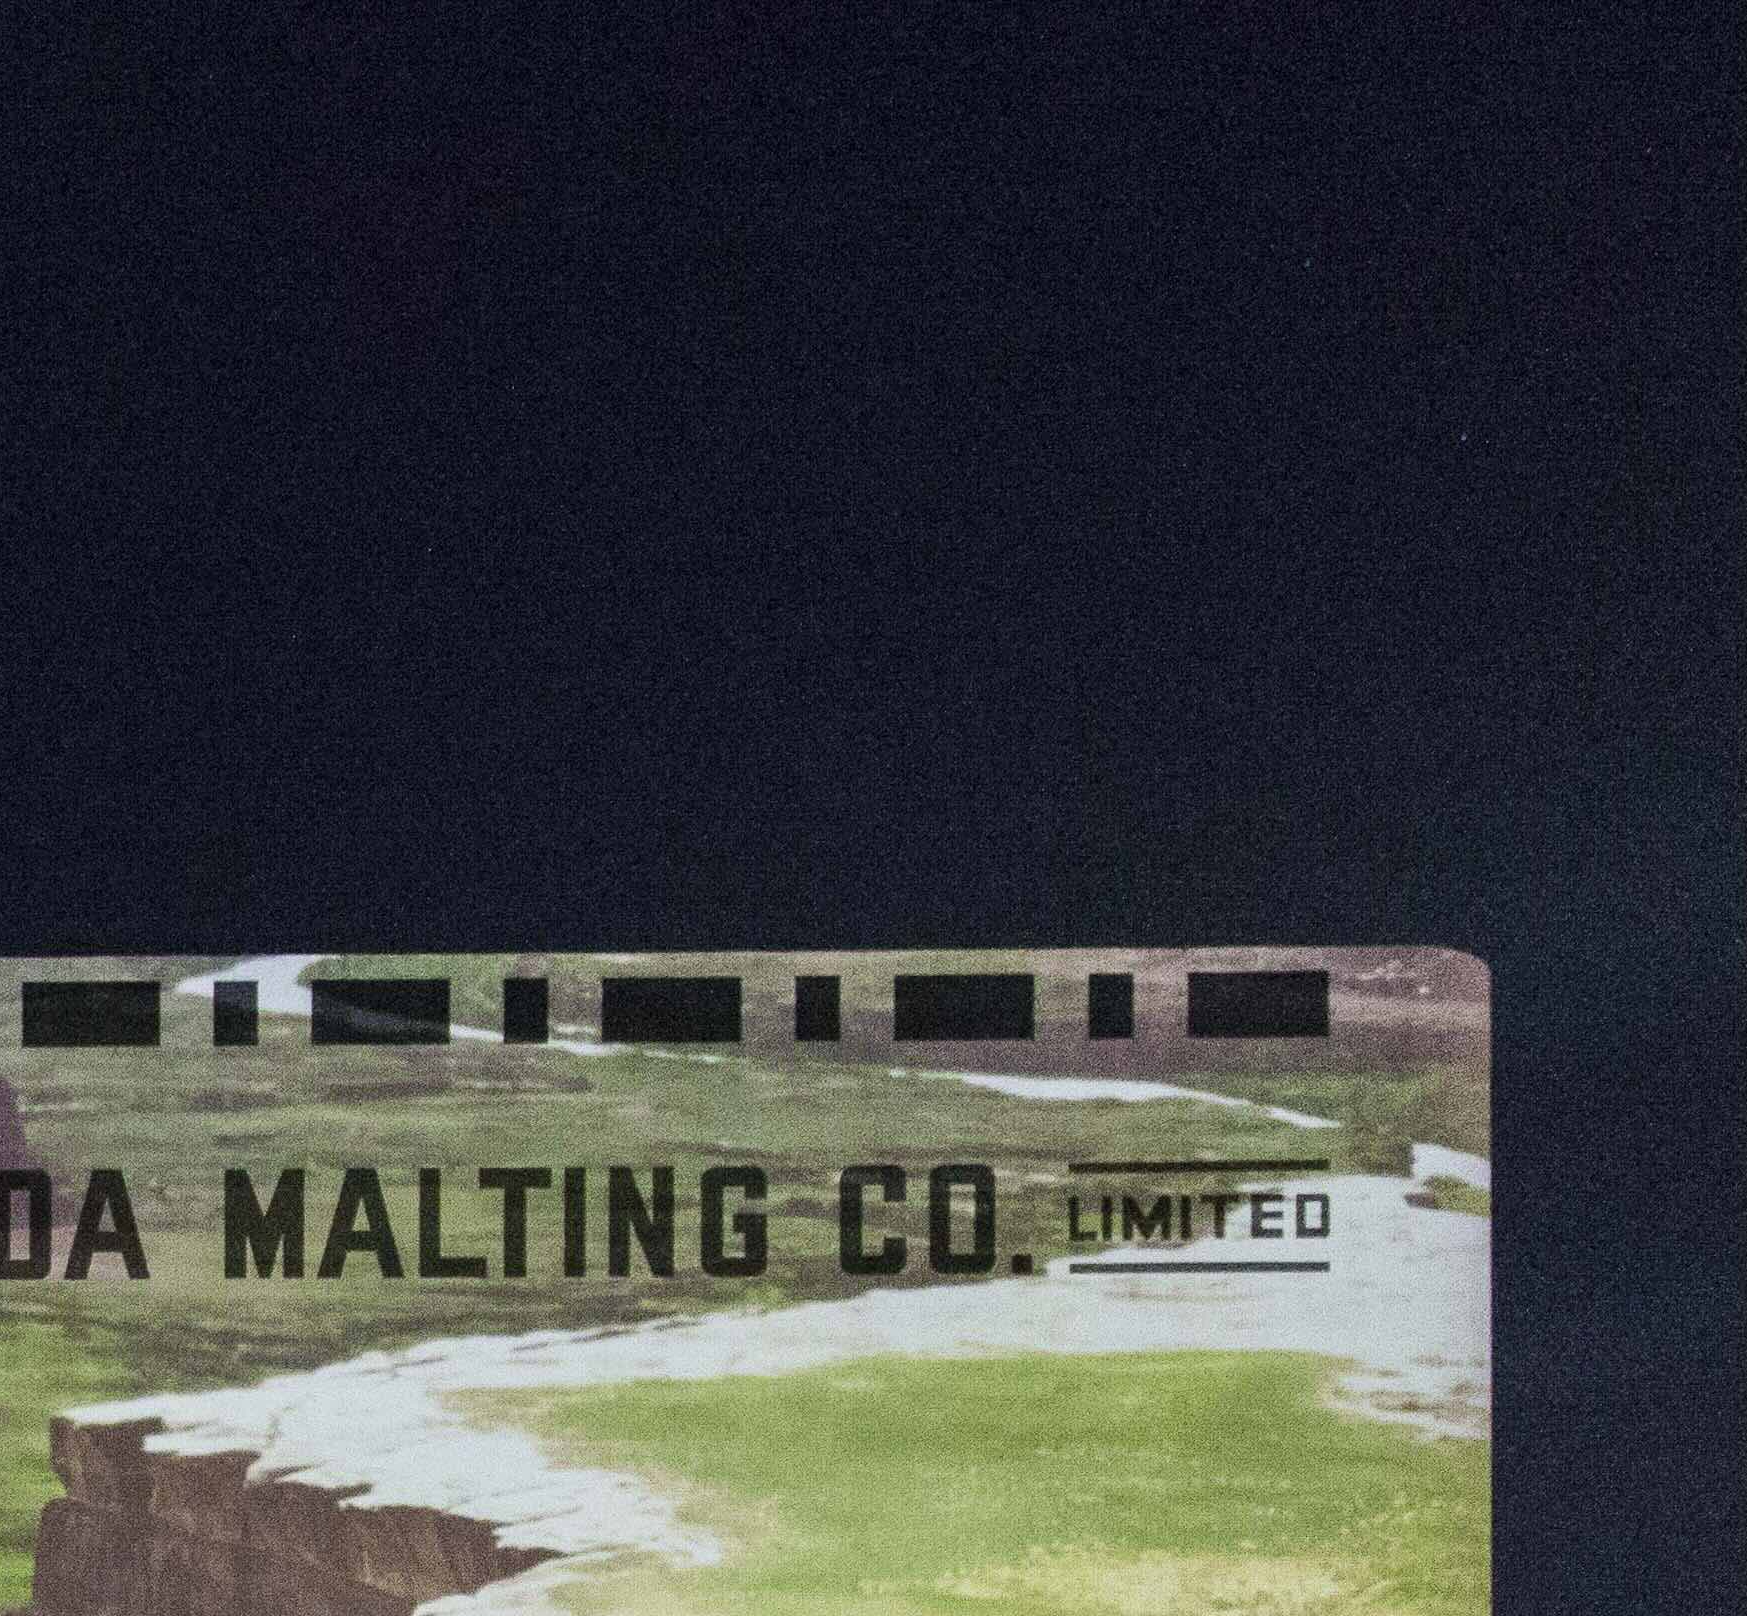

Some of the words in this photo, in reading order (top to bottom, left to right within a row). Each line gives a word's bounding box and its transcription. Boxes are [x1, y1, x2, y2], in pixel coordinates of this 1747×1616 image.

[225, 1167, 768, 1277] MALTING
[838, 1165, 1035, 1277] CO.
[1068, 1193, 1331, 1241] LIMITED
